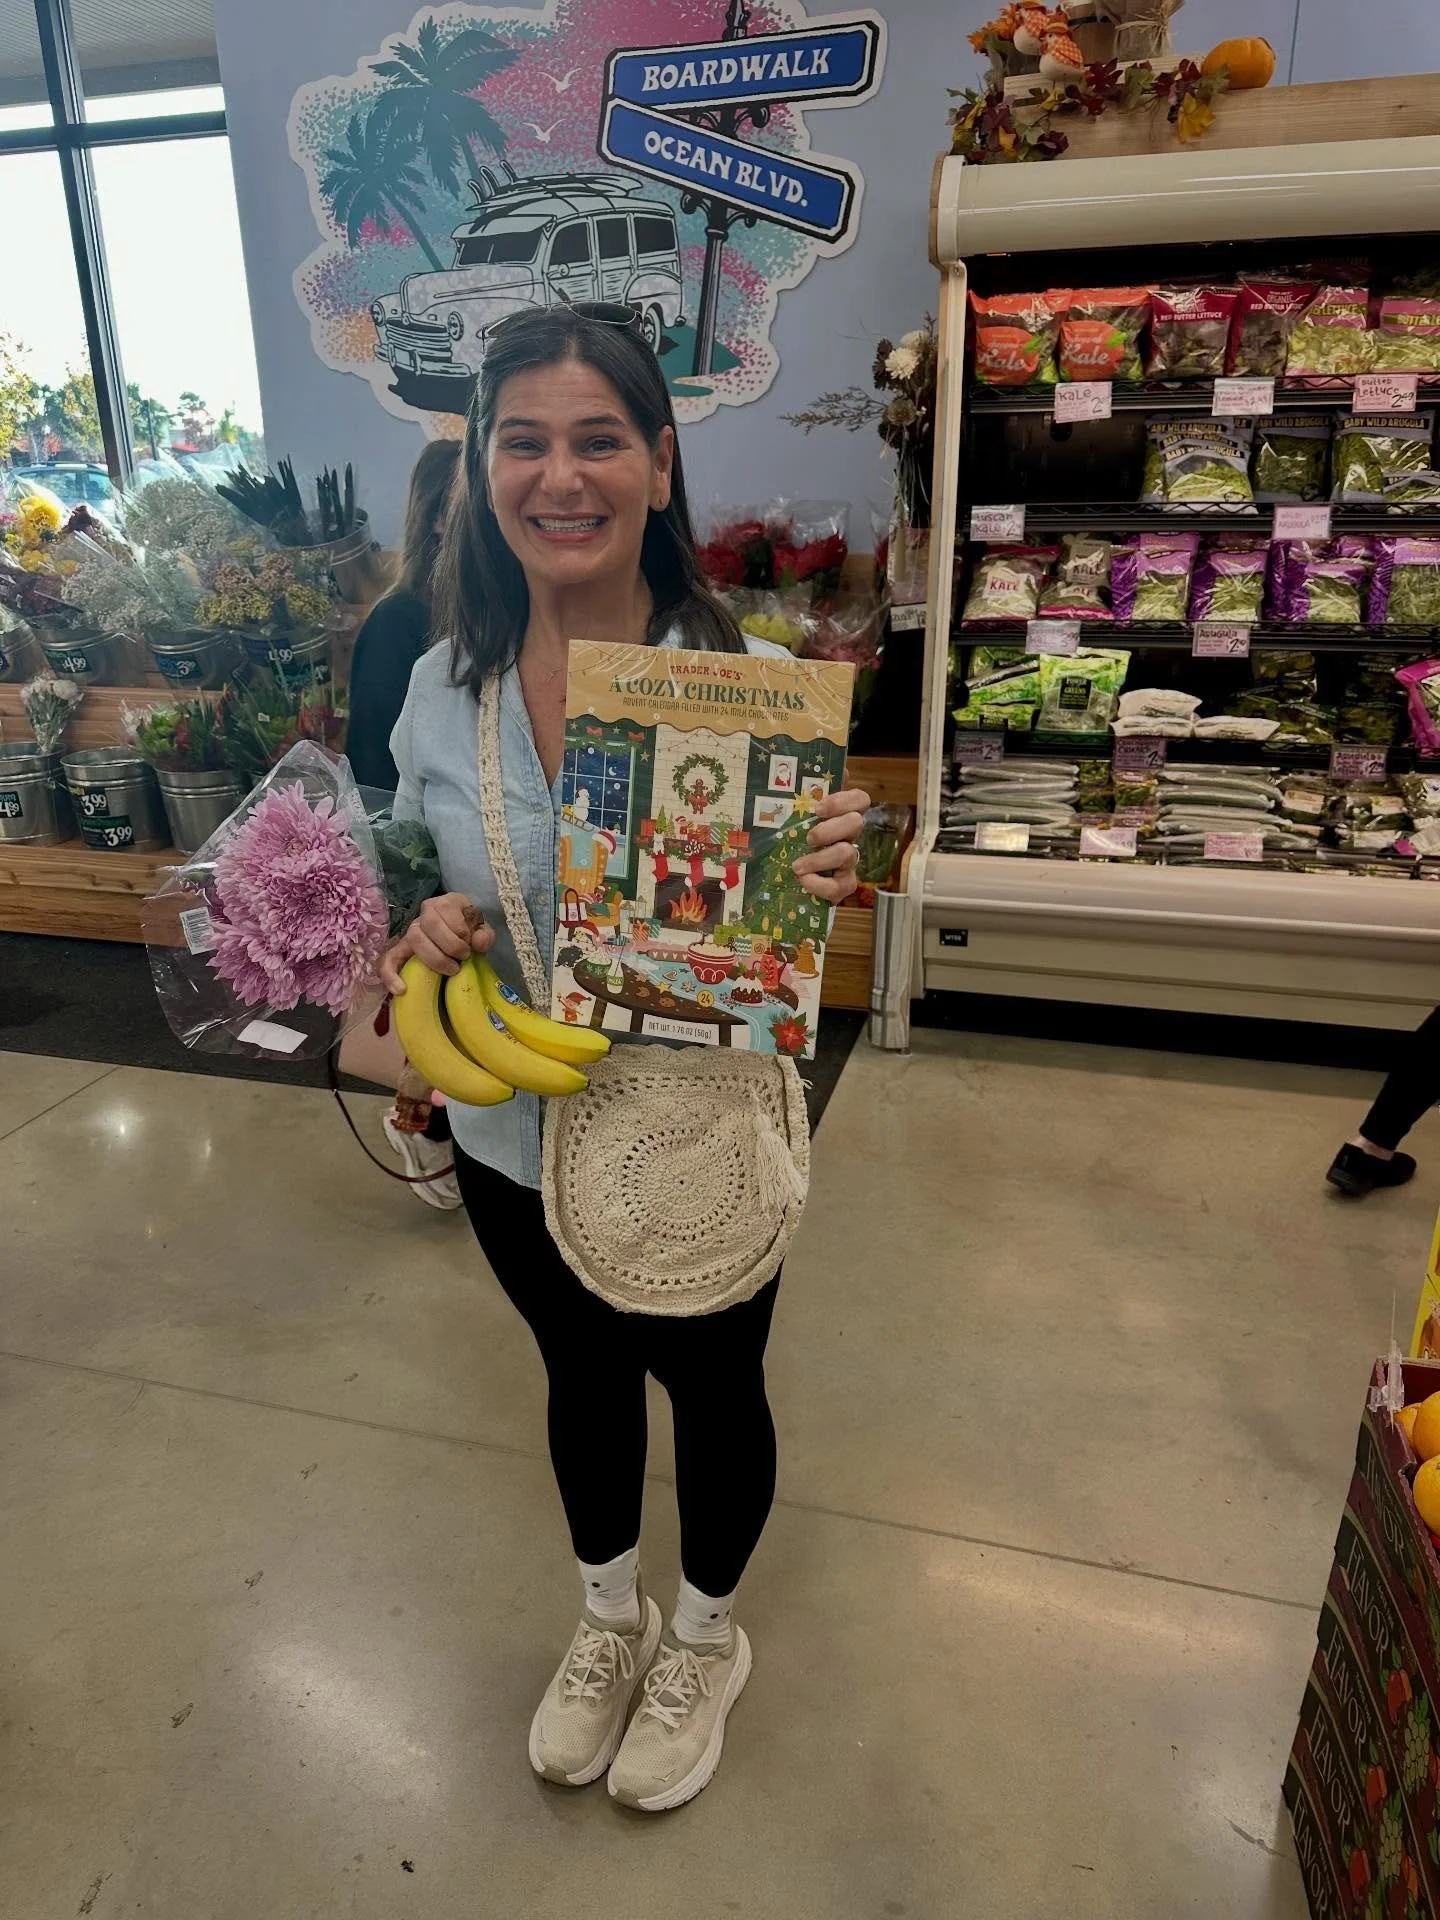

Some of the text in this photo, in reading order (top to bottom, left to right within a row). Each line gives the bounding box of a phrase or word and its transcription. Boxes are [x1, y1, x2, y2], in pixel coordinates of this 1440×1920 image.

[641, 48, 832, 92] BOARDWALK
[644, 130, 808, 207] OCEAN BLVD.
[1059, 342, 1110, 366] Kale
[1344, 417, 1426, 429] BABY WILD ARUGULA
[989, 580, 1019, 592] KALE
[670, 665, 742, 681] TRADER JOE'S
[608, 674, 806, 711] A COZY CHRISTMAS
[622, 696, 648, 708] ADVENT
[648, 699, 681, 711] CALENDAR
[681, 702, 701, 713] FILLED
[702, 704, 720, 715] WITH
[720, 706, 729, 716] 24
[730, 707, 747, 718] MILK
[700, 993, 711, 1005] 24
[648, 1021, 660, 1031] NET
[685, 1027, 694, 1036] OZ
[694, 1028, 712, 1040] (50g)
[1346, 1535, 1390, 1670] FLAVOR
[1327, 1624, 1368, 1760] FLAVOR
[1309, 1704, 1351, 1845] FLAVOR
